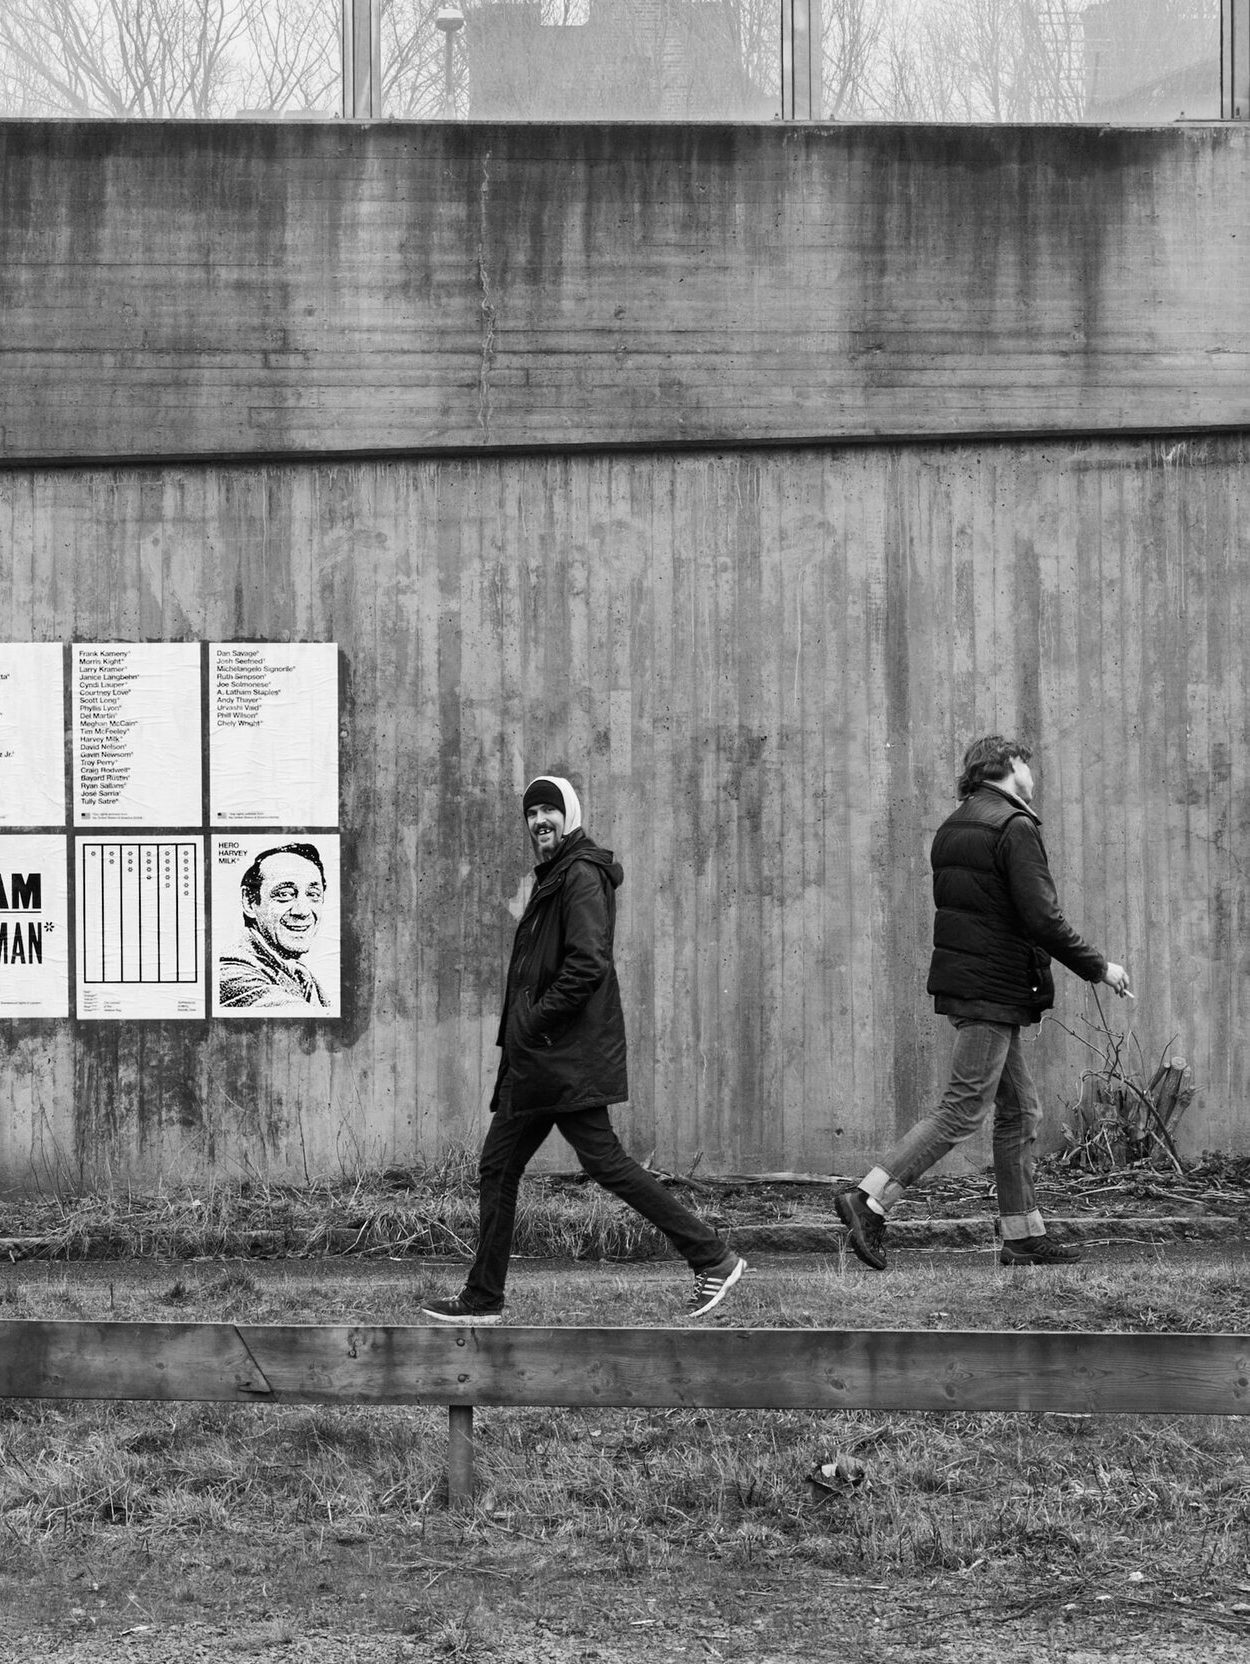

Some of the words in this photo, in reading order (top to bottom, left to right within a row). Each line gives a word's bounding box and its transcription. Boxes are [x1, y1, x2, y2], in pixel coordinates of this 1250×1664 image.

[79, 666, 98, 674] Larry
[216, 666, 262, 674] Michelangelo
[79, 682, 100, 690] Cyndi
[217, 697, 235, 705] Andy
[79, 705, 102, 713] Phyllis
[217, 720, 237, 728] Chely
[80, 736, 104, 744] Harvey
[80, 767, 99, 775] Craig
[80, 775, 105, 783] Bayard
[81, 798, 97, 806] Tully
